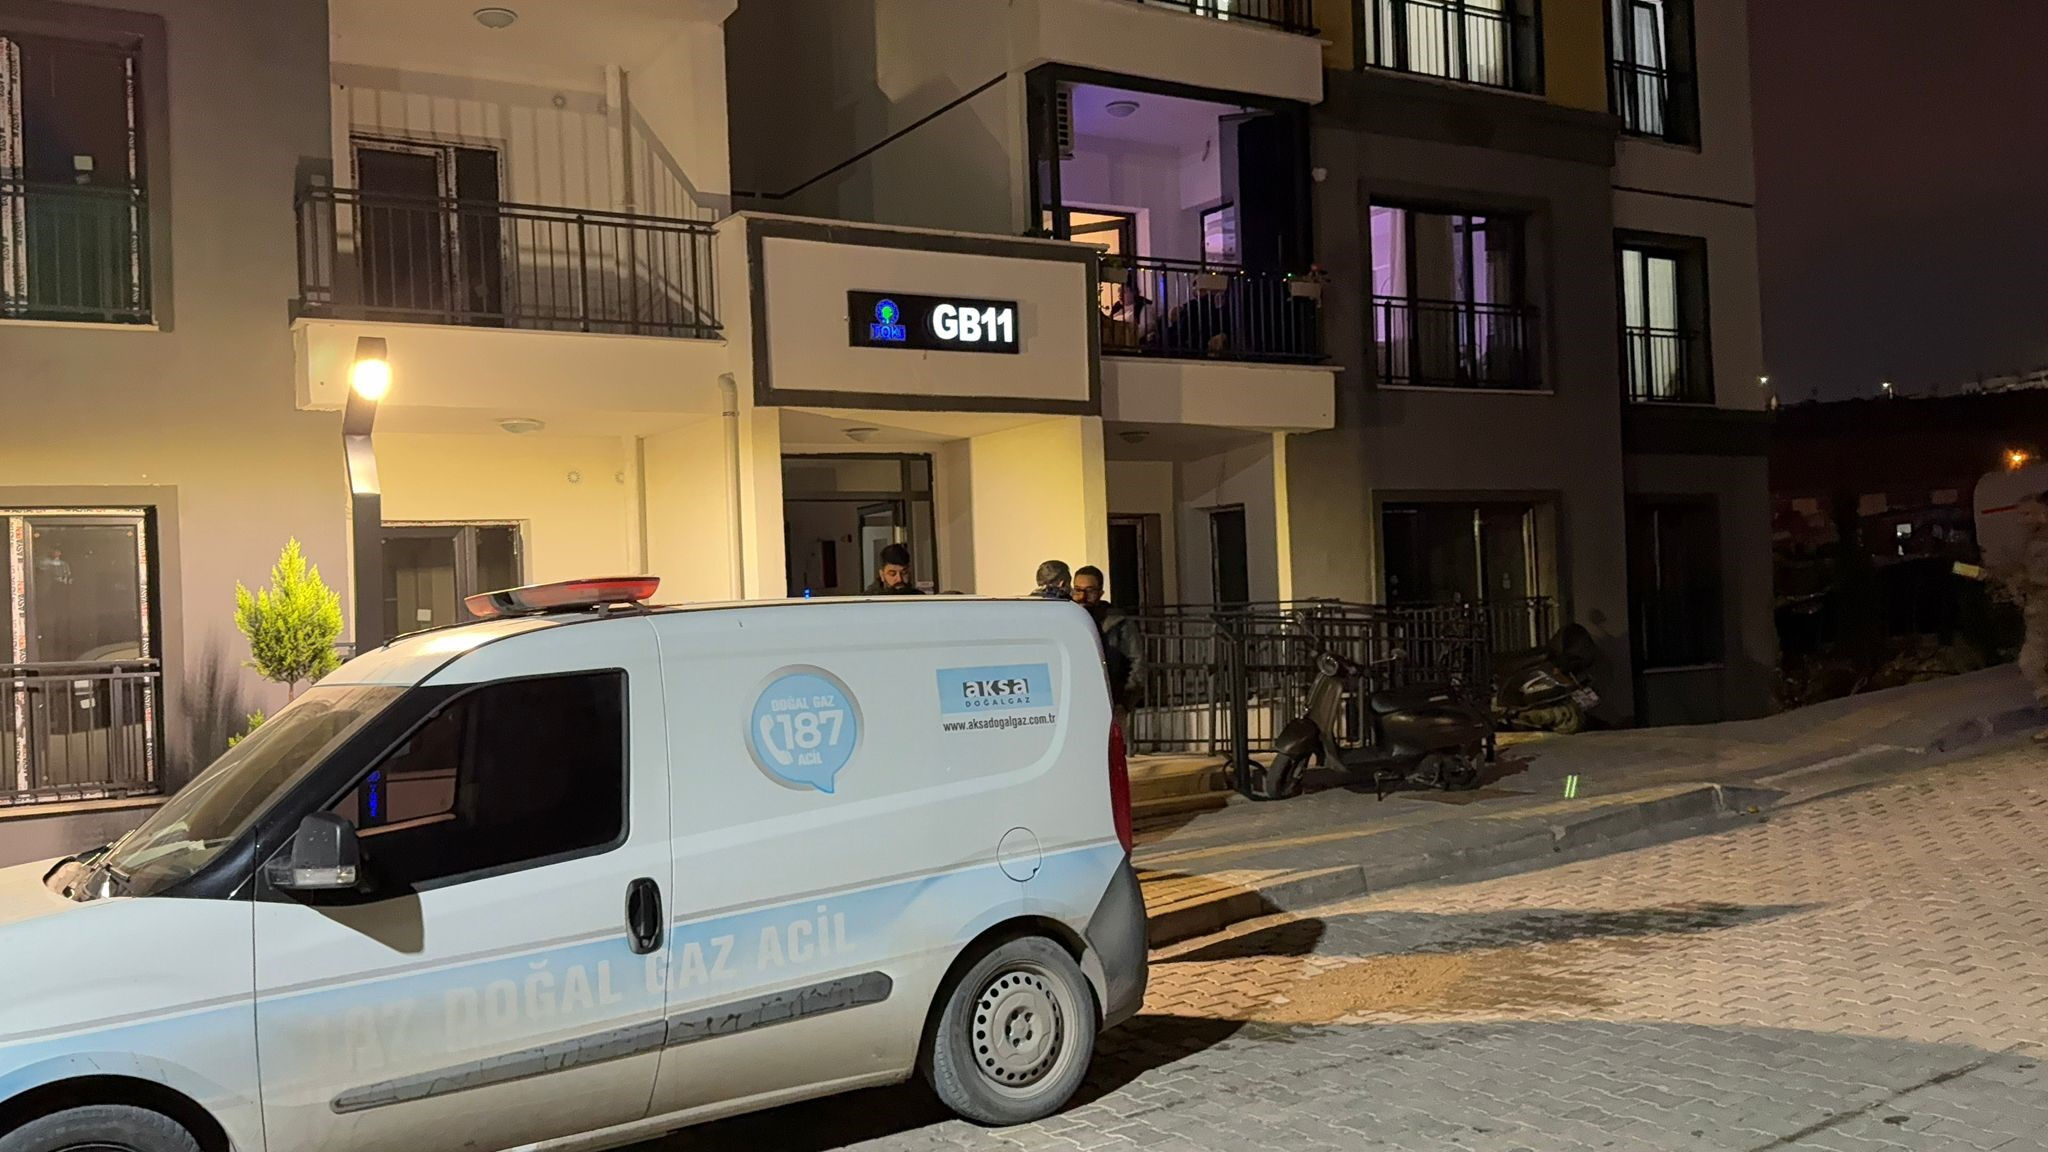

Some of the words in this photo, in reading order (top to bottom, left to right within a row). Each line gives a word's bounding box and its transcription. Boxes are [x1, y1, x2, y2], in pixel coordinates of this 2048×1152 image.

[933, 304, 1013, 343] GB11
[964, 679, 1029, 698] aksa
[771, 695, 809, 712] DOĞAL
[813, 695, 835, 708] GAZ
[965, 697, 1031, 708] DOĞALGAZ
[776, 709, 844, 750] 187
[943, 713, 1056, 732] www.aksadogalgaz.com.tr
[446, 959, 623, 1044] DOĞAL
[645, 935, 738, 994] GAZ
[757, 905, 856, 970] ACİL
